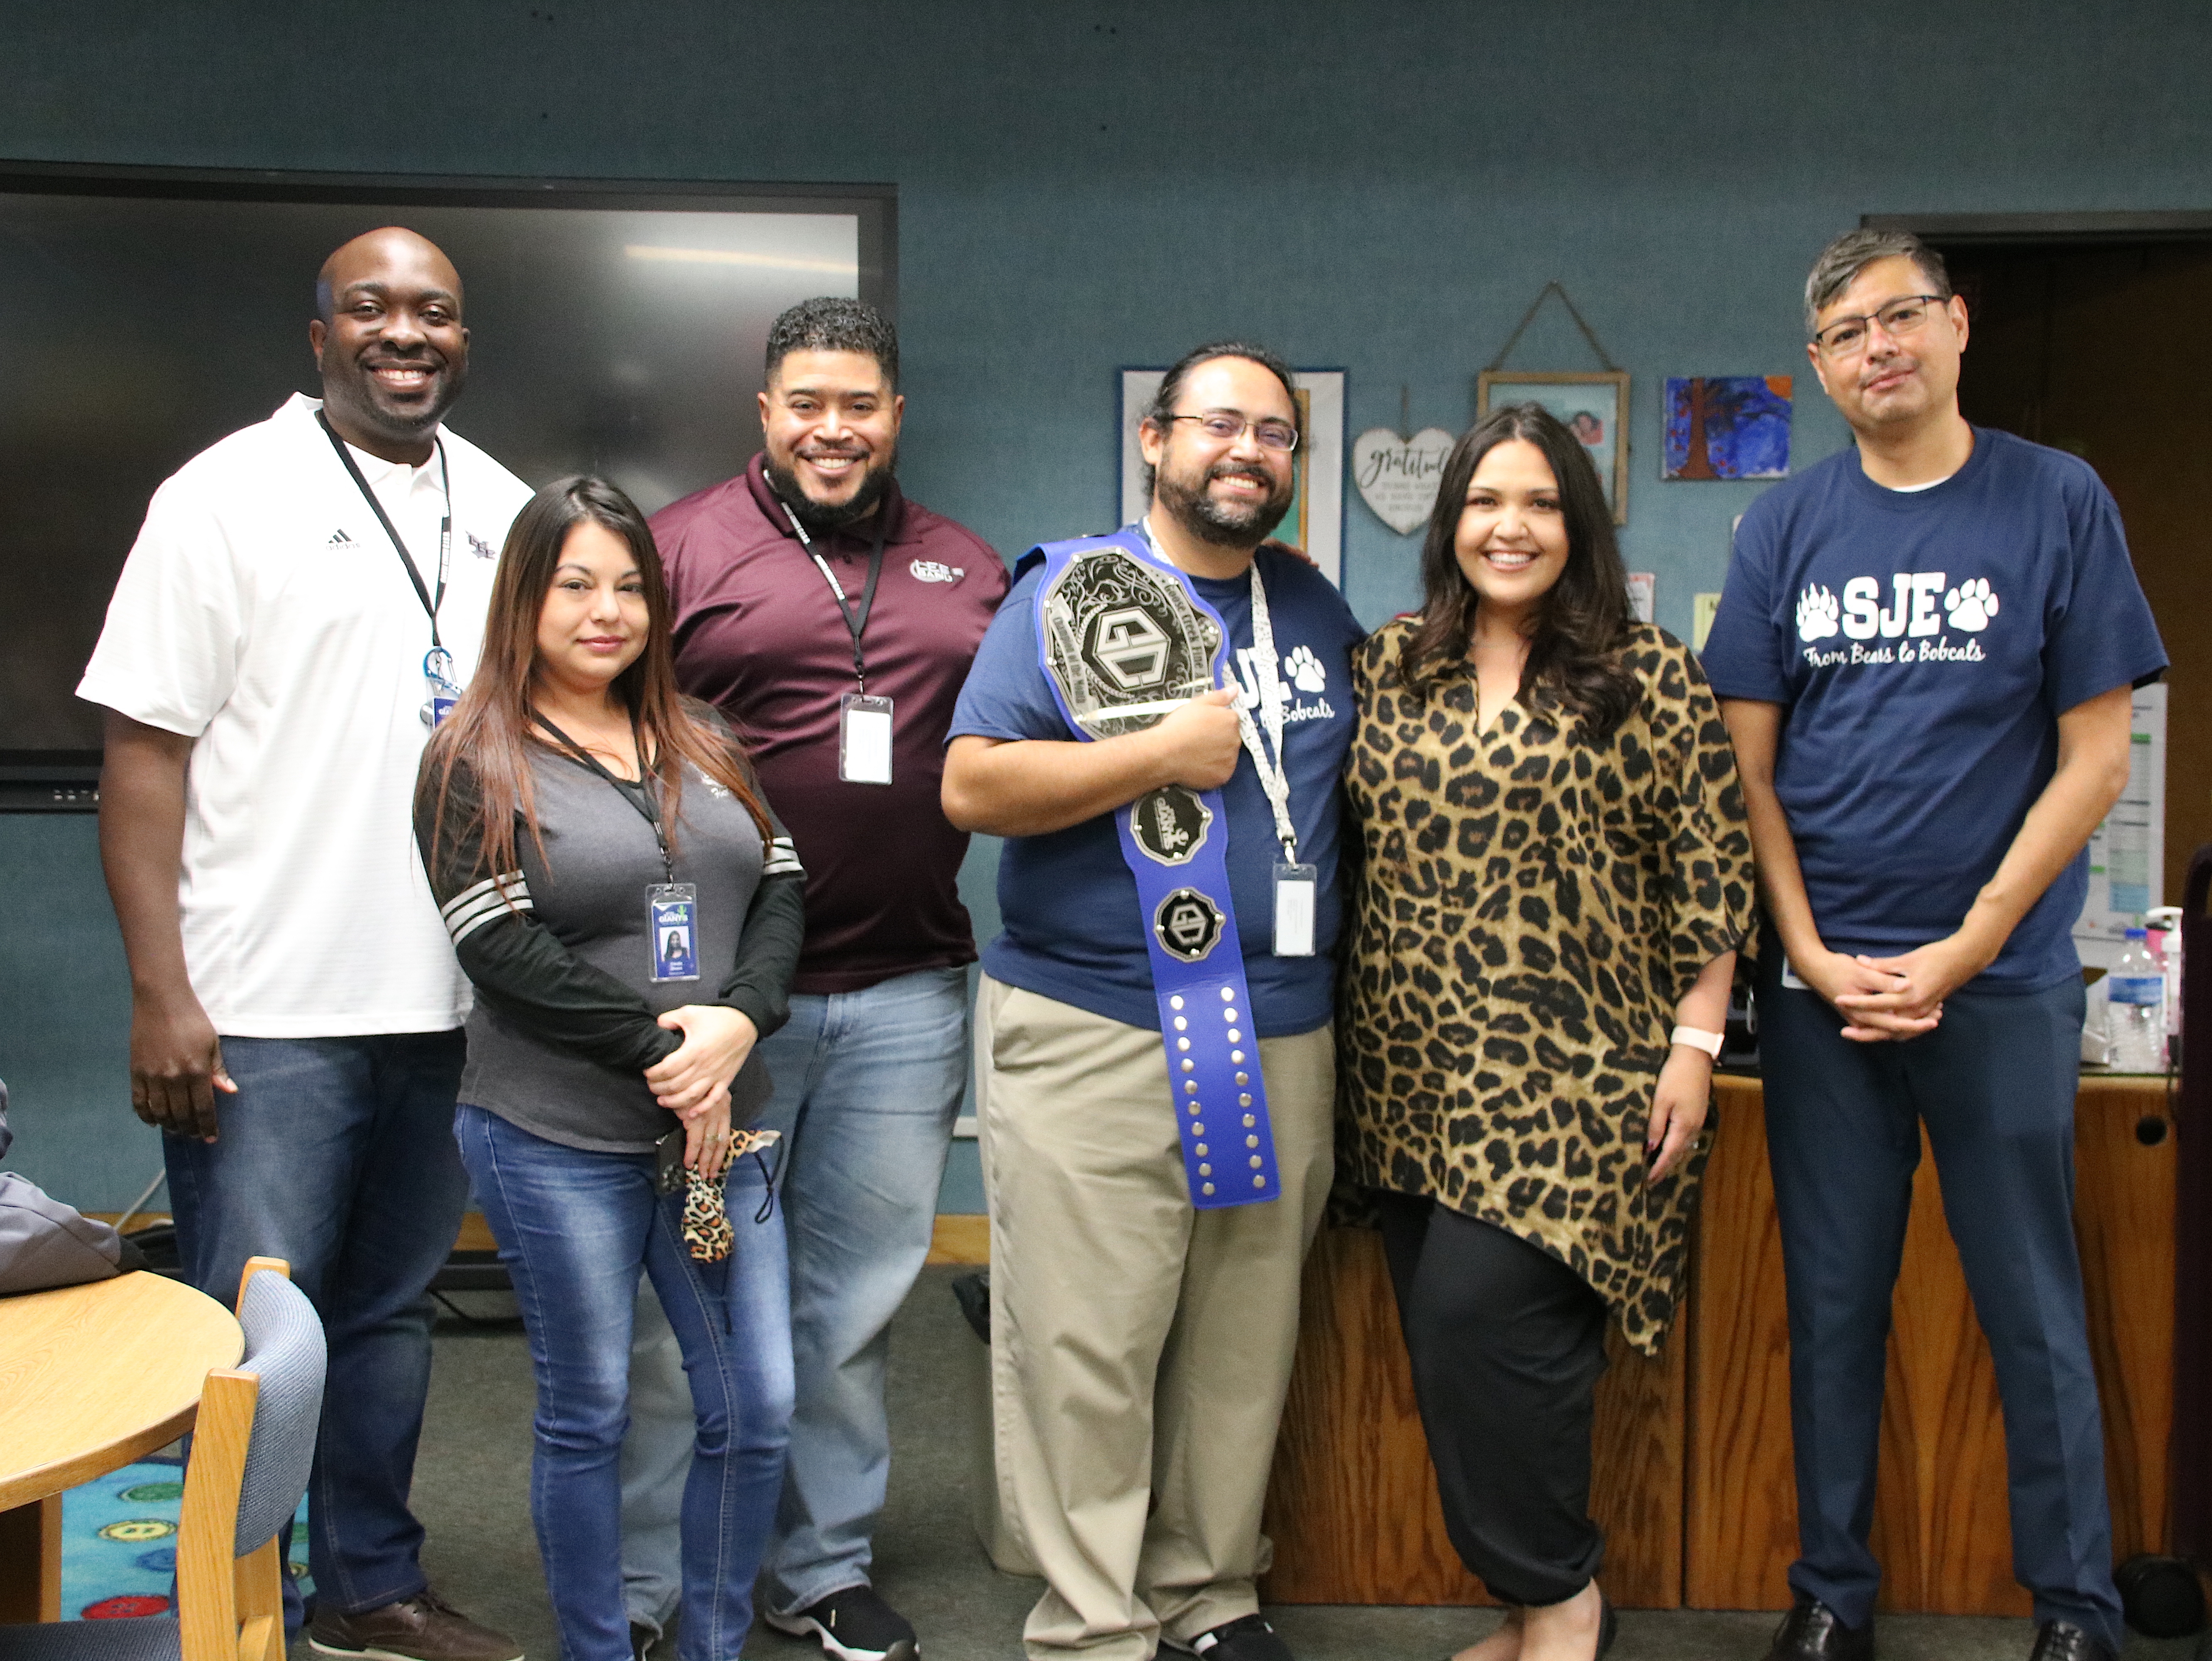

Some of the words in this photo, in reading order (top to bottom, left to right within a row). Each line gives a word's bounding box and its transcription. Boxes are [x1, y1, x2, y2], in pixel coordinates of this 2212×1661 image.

[1360, 447, 1451, 488] gratitud
[326, 542, 360, 551] adidas
[1842, 572, 1946, 640] SJE
[1803, 646, 1848, 667] From
[1850, 642, 1896, 664] Bears
[1898, 640, 1916, 663] to
[1918, 635, 1987, 662] Bobcats
